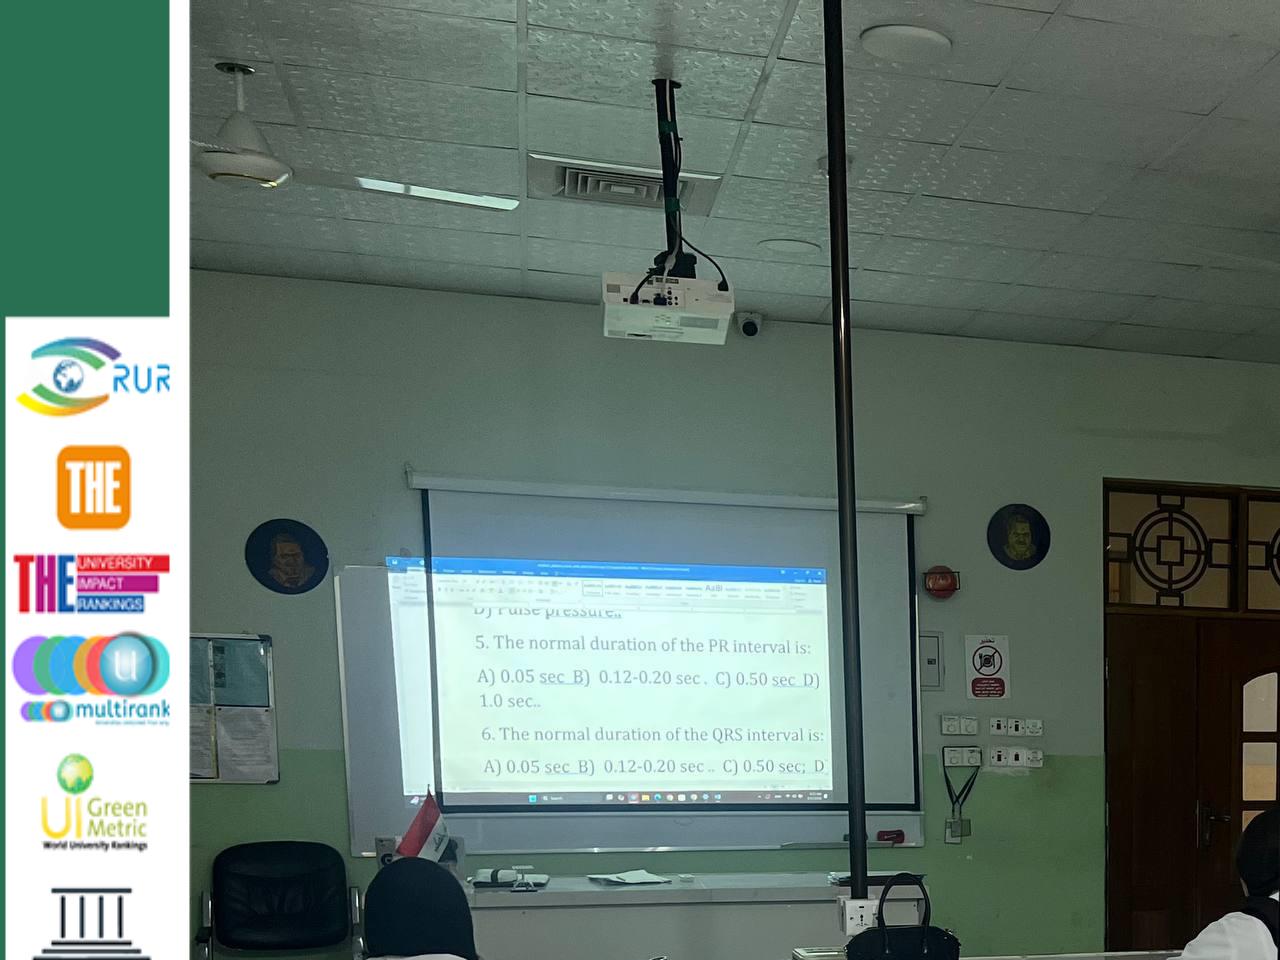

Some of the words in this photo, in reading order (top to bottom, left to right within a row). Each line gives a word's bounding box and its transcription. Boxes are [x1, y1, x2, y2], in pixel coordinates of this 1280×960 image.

[475, 635, 489, 650] 5.
[493, 635, 524, 650] The
[529, 635, 585, 650] normal
[590, 636, 657, 651] duration
[661, 637, 678, 652] of
[680, 638, 704, 652] the
[709, 639, 729, 653] PR
[733, 639, 790, 654] interval
[796, 641, 811, 655] is:
[477, 669, 495, 686] A)
[501, 669, 535, 684] 0.05
[573, 669, 590, 687] B)
[599, 670, 672, 685] 0.12-0.20
[715, 671, 731, 688] C)
[736, 672, 768, 686] 0.50
[803, 672, 820, 689] D)
[480, 693, 503, 708] 1.0
[481, 727, 496, 741] 6.
[499, 726, 530, 741] The
[535, 726, 590, 741] normal
[595, 727, 661, 741] duration
[665, 727, 682, 741] of
[685, 727, 708, 741] the
[712, 728, 743, 744] QRS
[747, 728, 804, 742] interval
[808, 728, 824, 742] is:
[483, 759, 501, 776] A)
[507, 759, 540, 774] 0.05
[579, 759, 595, 776] B)
[604, 759, 676, 774] 0.12-0.20
[723, 759, 738, 776] C)
[743, 759, 774, 773] 0.50
